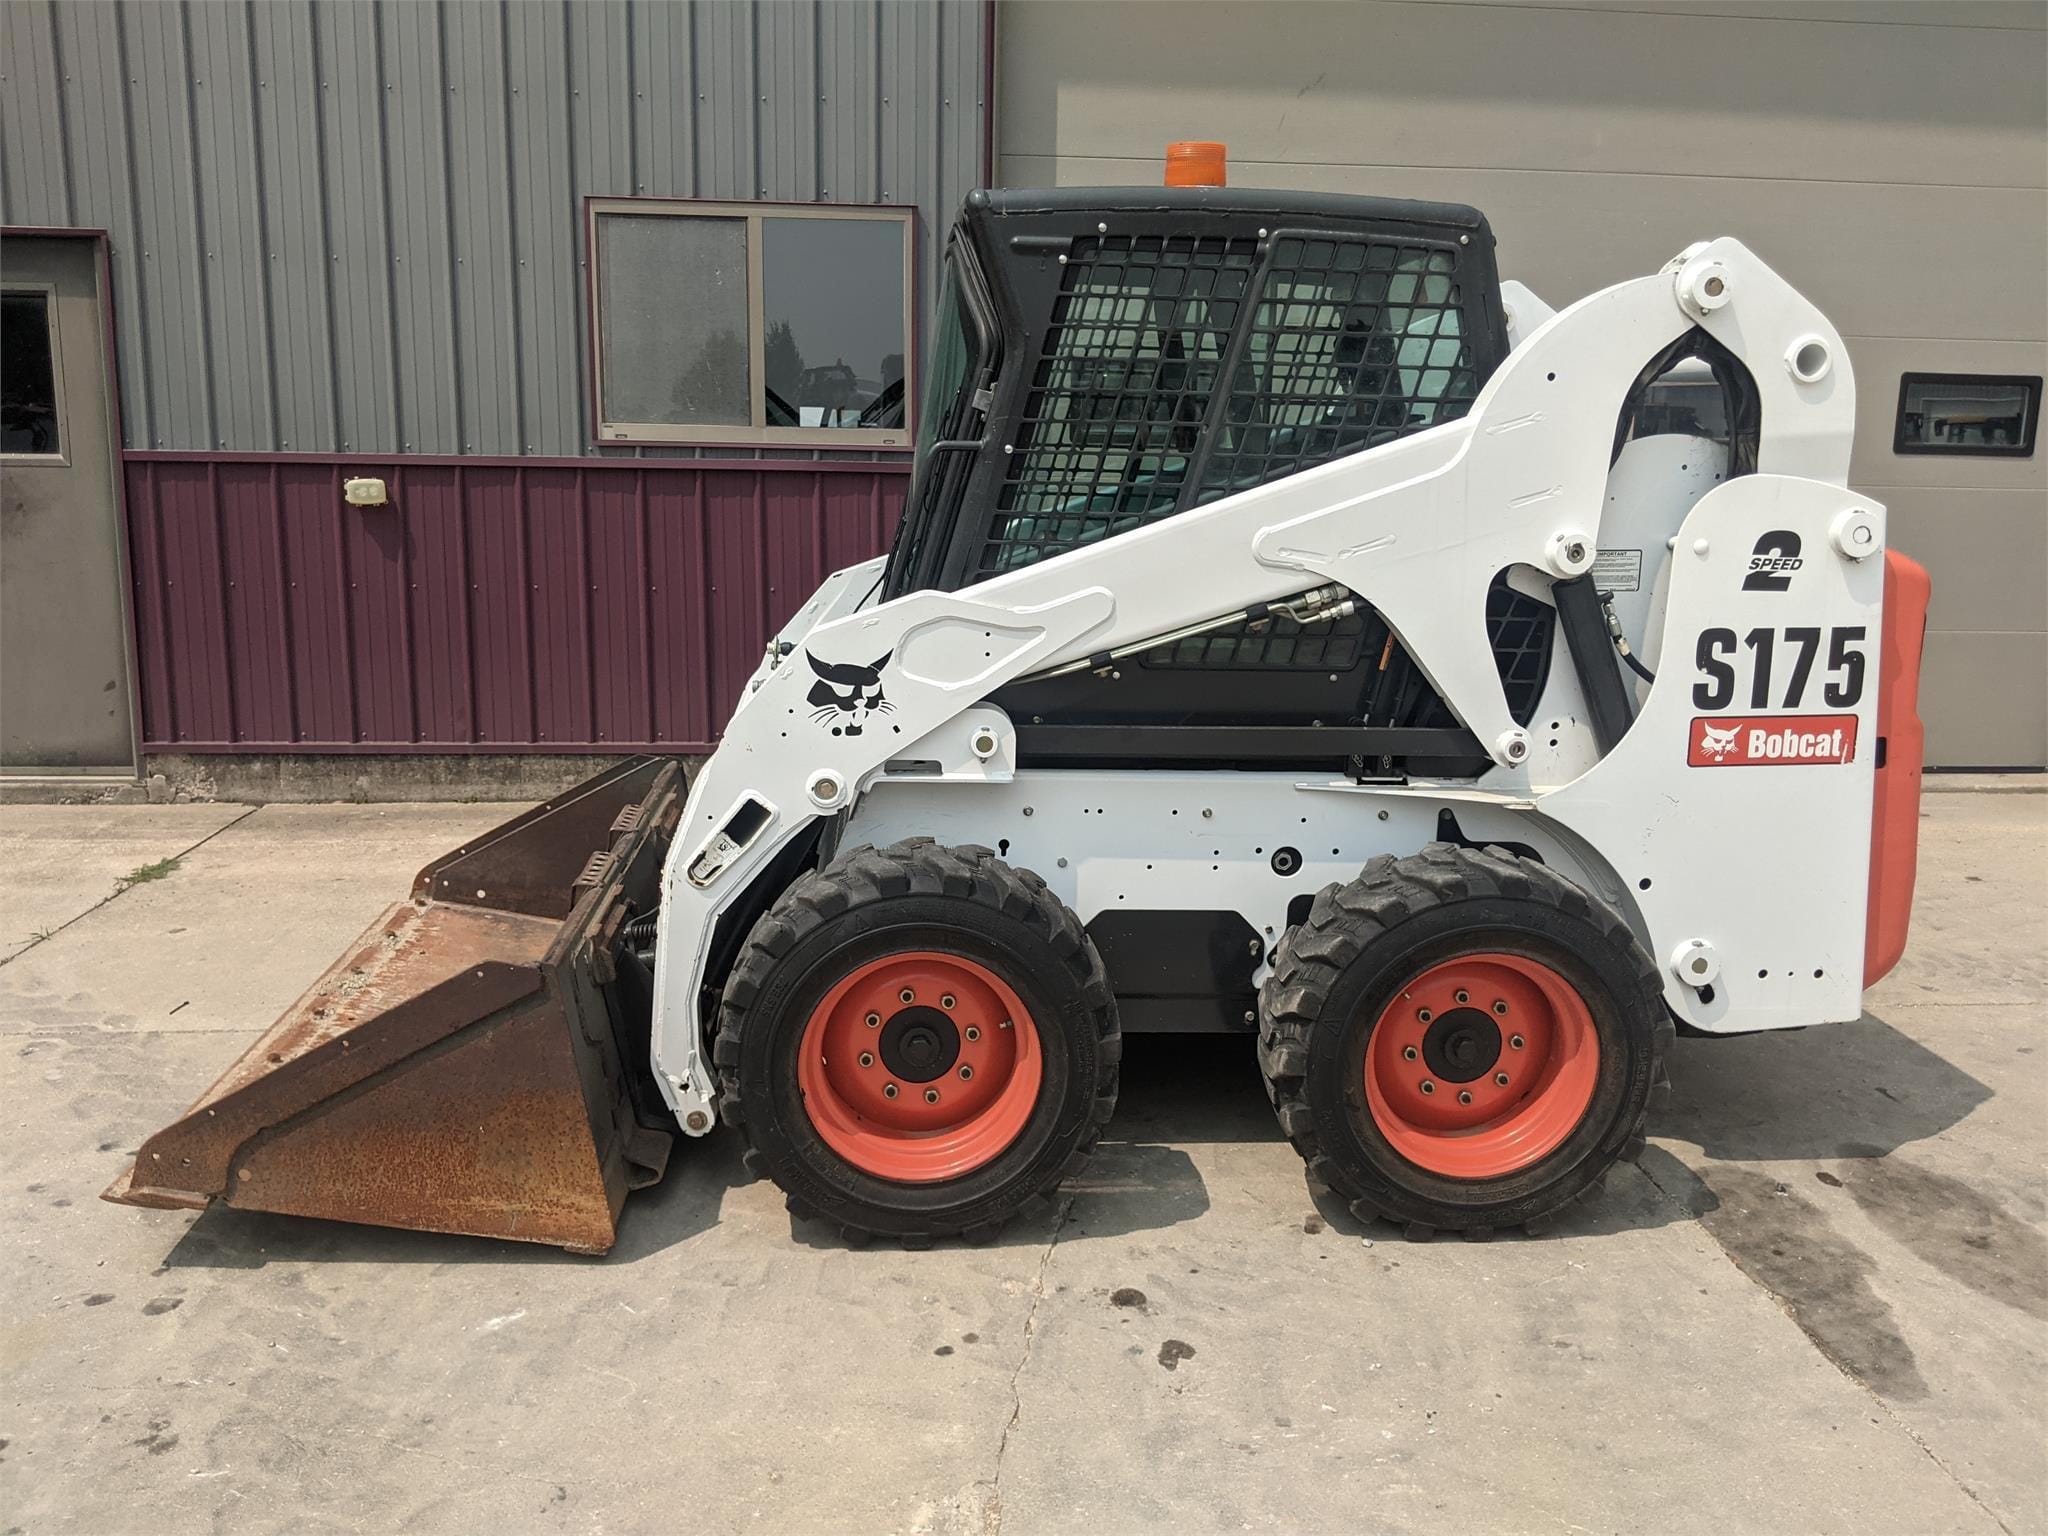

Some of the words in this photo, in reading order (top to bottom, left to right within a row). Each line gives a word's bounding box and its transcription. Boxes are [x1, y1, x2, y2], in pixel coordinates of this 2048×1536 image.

[1741, 530, 1802, 592] 2
[1748, 557, 1804, 571] SPEED
[1692, 626, 1867, 711] S175
[1747, 728, 1842, 759] Bobcat
